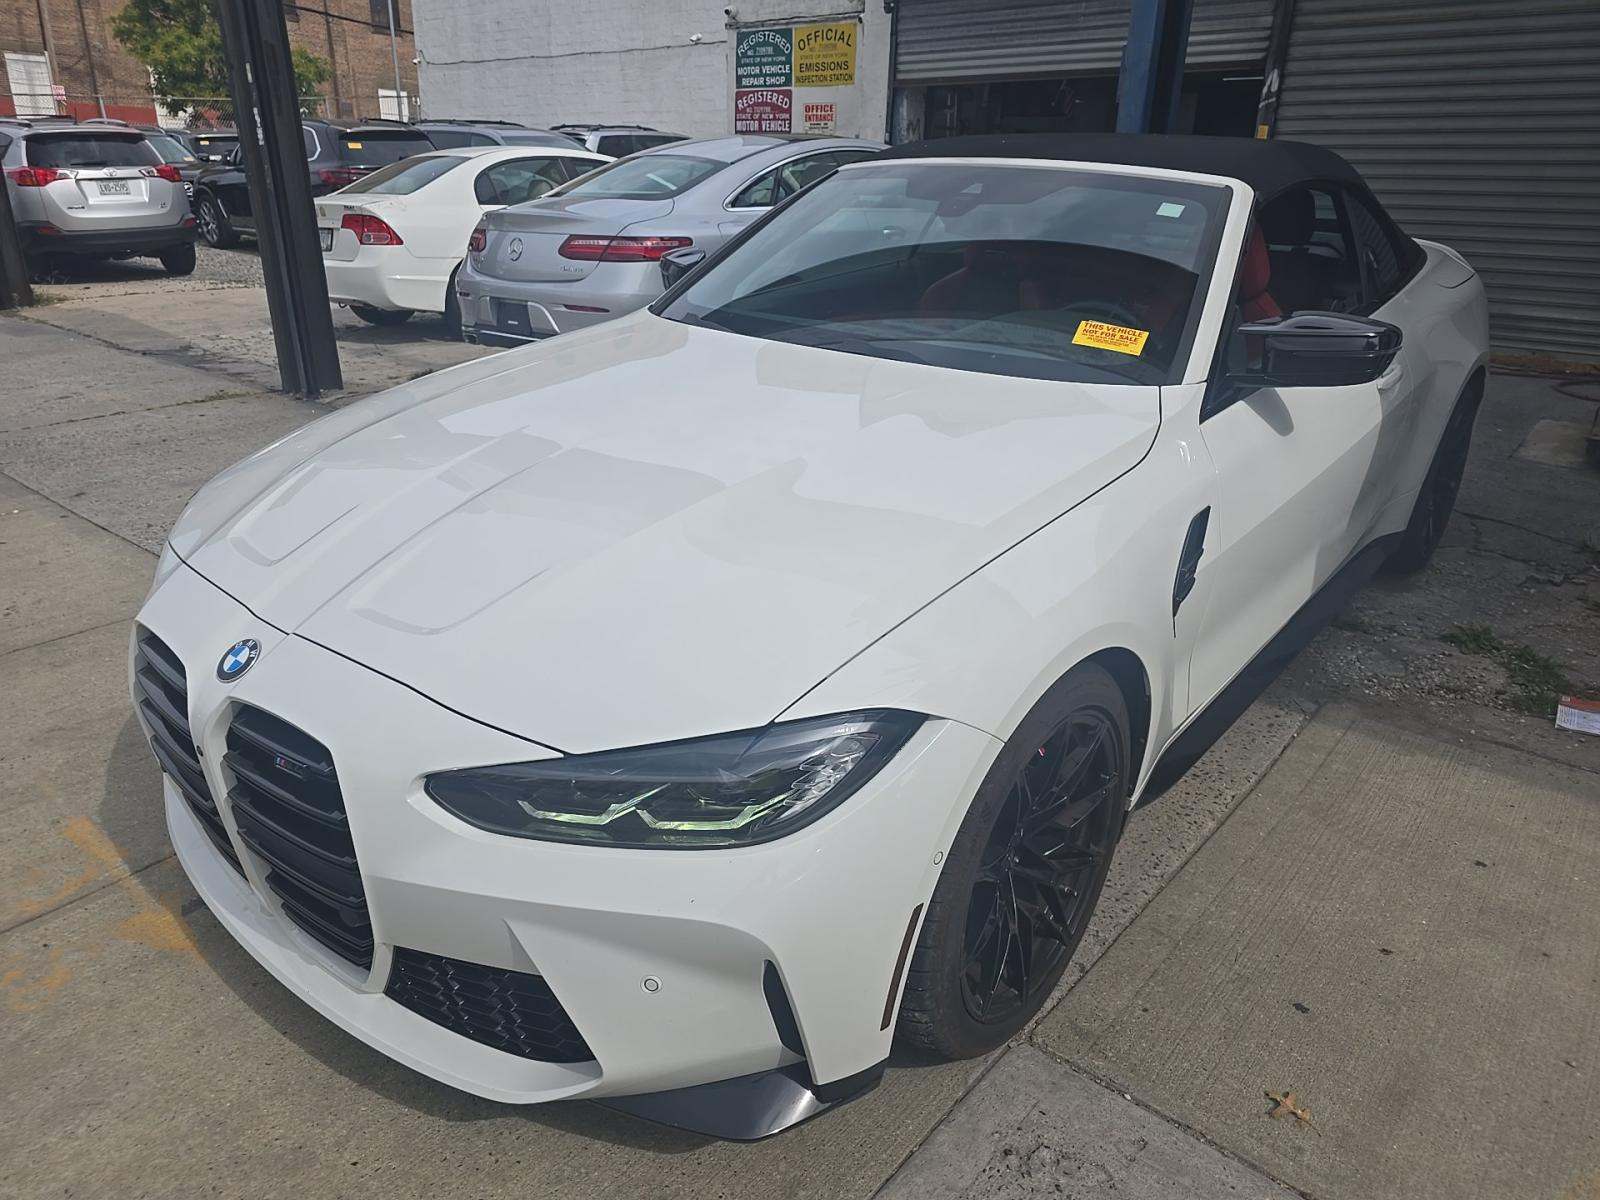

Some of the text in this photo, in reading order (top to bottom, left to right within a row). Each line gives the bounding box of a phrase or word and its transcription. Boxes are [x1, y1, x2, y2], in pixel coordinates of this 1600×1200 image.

[737, 31, 791, 57] REGISTERED
[797, 28, 852, 51] OFFICIAL
[737, 65, 791, 76] MOTOR VEHICLE
[799, 60, 849, 73] EMISSIONS
[742, 76, 785, 86] REPAIR SHOP
[796, 73, 853, 84] INSPECTION STATION
[736, 91, 790, 111] REGISTERED
[805, 104, 834, 113] OFFICE
[805, 113, 834, 122] ENTRANCE
[736, 120, 790, 132] MOTOR VEHICLE
[1085, 322, 1143, 337] THIS VEHICLE
[1100, 331, 1117, 339] FOR
